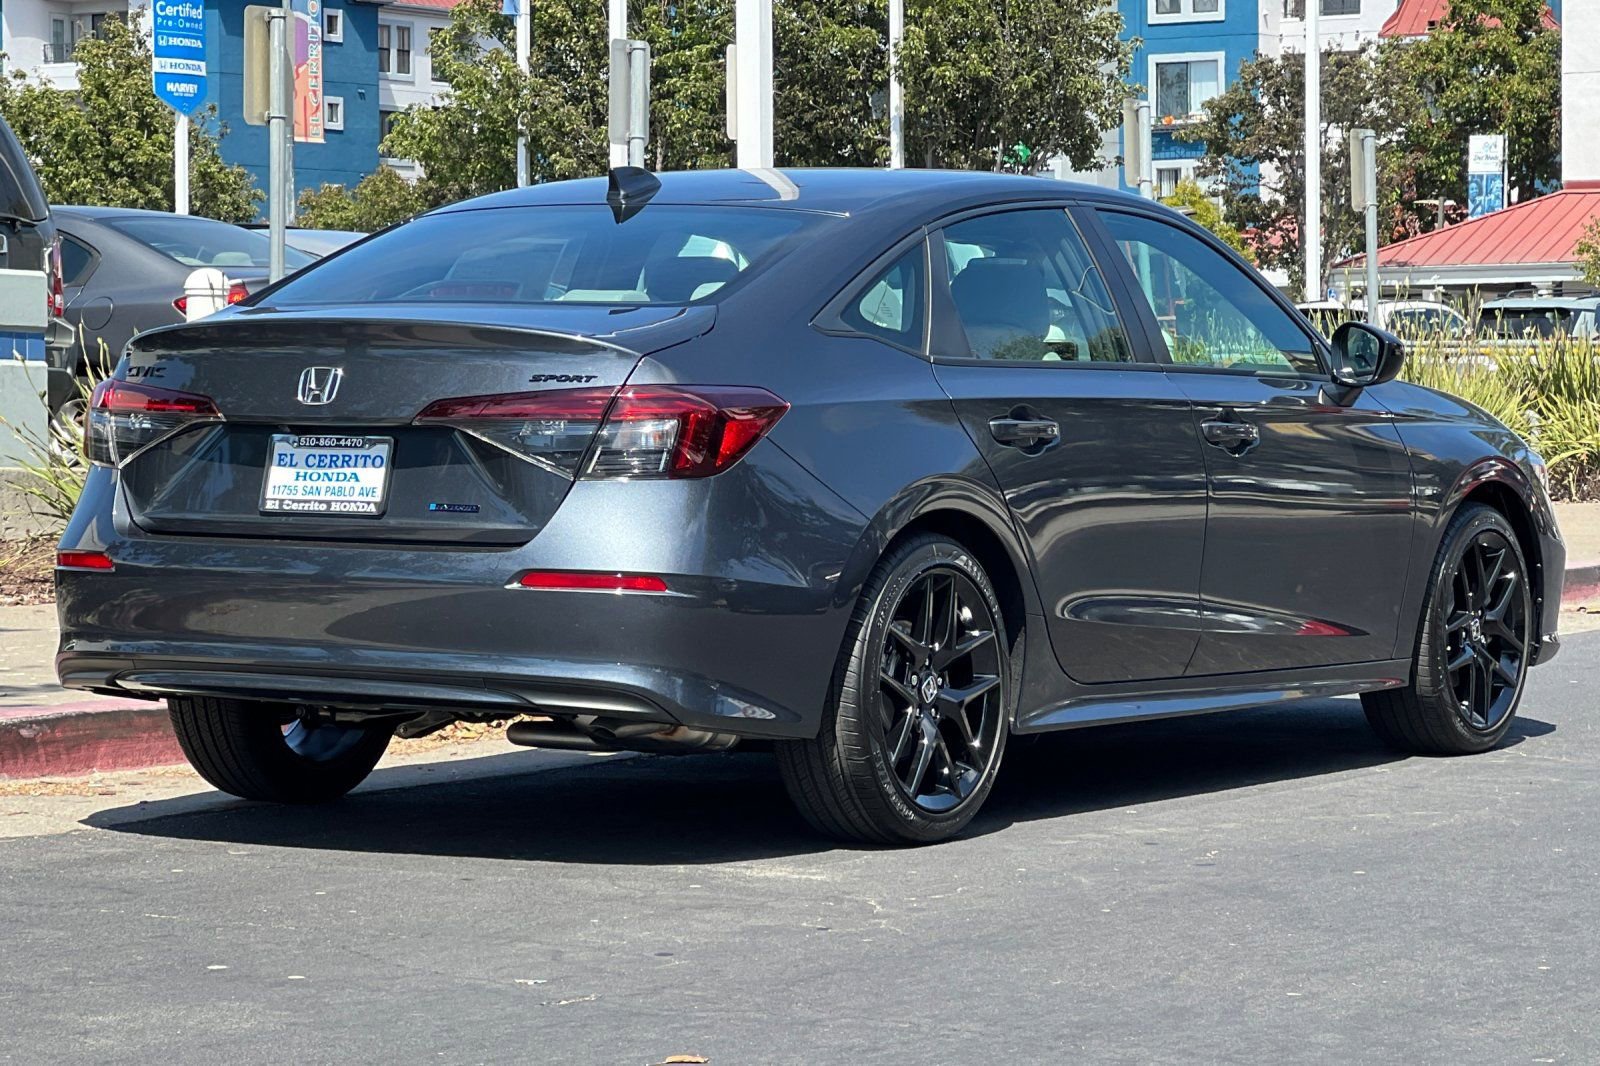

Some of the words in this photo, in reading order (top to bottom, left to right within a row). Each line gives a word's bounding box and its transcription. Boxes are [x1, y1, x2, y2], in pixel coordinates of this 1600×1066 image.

[156, 1, 202, 19] Certified
[157, 17, 203, 30] Pre-Owned
[168, 36, 203, 49] HONDA
[170, 62, 202, 72] HONDA
[167, 82, 198, 94] HARVEY
[529, 374, 598, 383] SPORT
[299, 437, 363, 448] 510-860-4470
[277, 453, 299, 468] EL
[305, 453, 385, 469] CERRITO
[294, 471, 360, 483] HONDA
[272, 485, 299, 496] 11755
[301, 486, 321, 497] SAN
[324, 486, 355, 498] PABLO
[265, 500, 279, 510] El
[282, 500, 327, 511] Cerrito
[330, 501, 376, 512] HONDA
